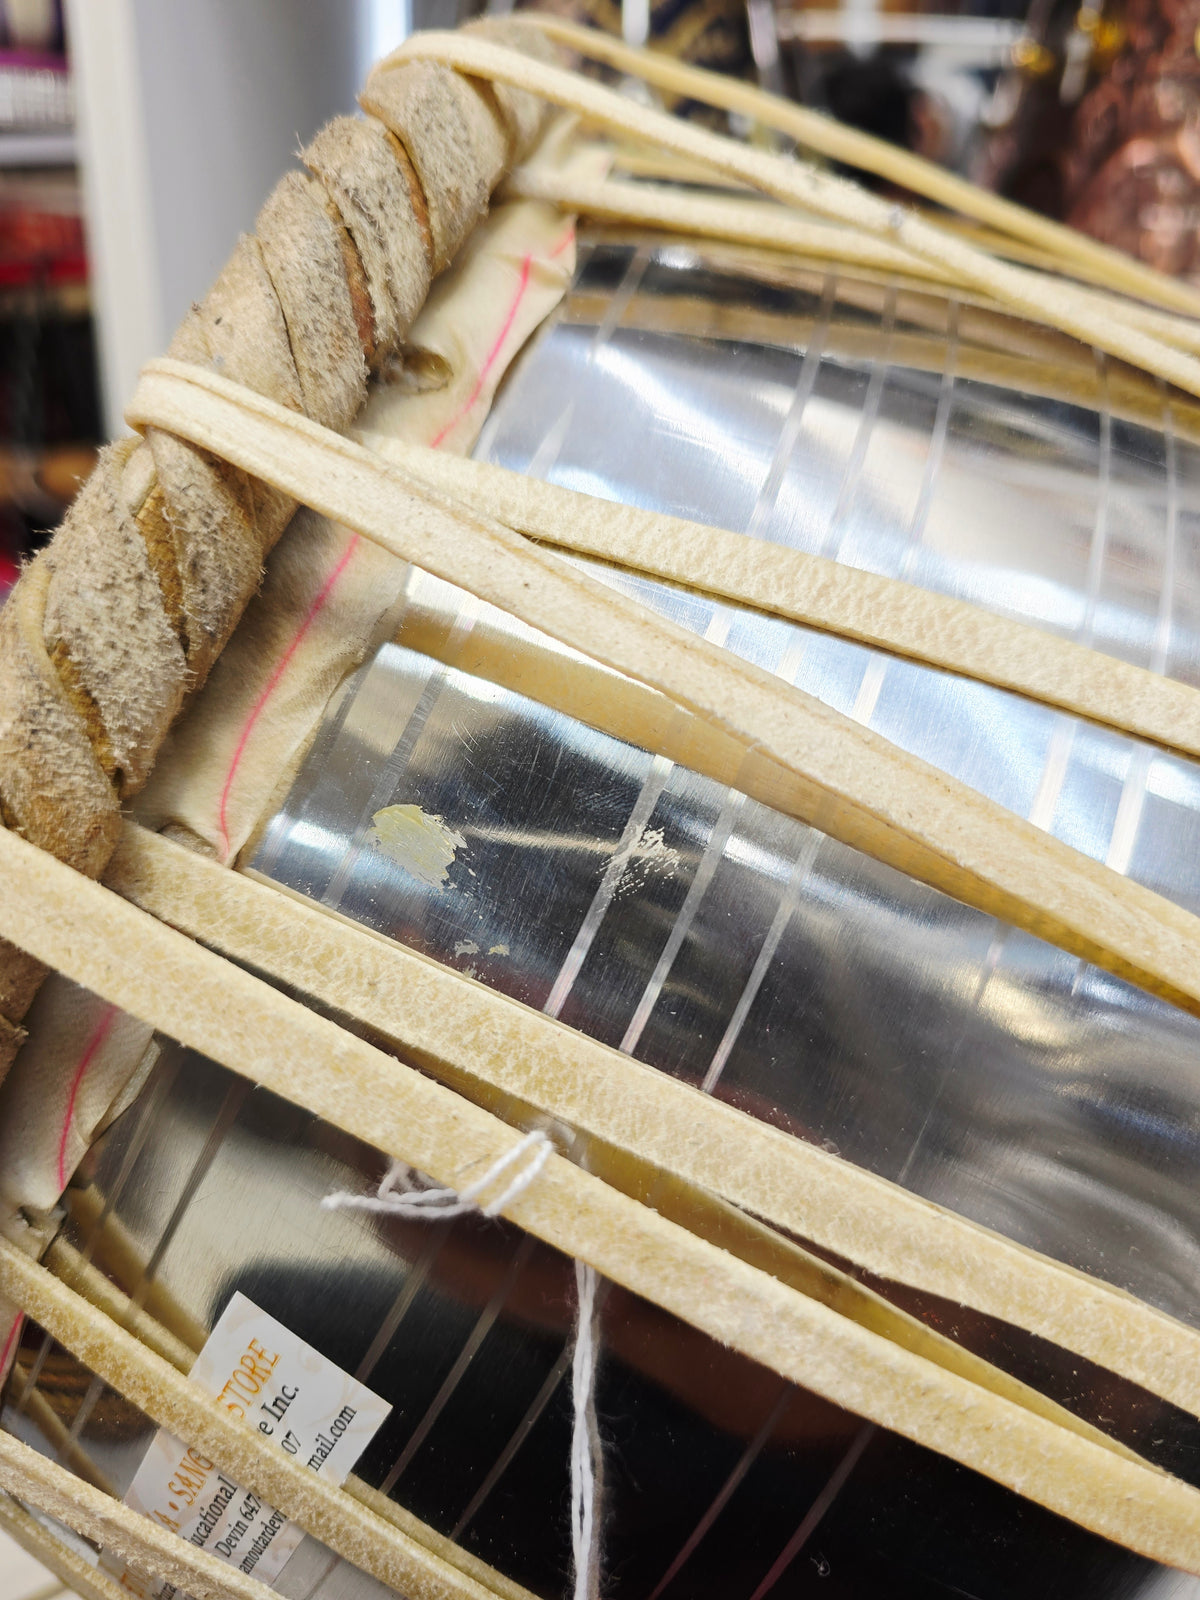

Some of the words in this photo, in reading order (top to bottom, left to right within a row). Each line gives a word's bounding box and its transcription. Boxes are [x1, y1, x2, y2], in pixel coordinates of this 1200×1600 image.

[217, 1338, 281, 1418] STORE
[183, 1475, 238, 1547] ucational
[261, 1384, 300, 1422] Inc.
[214, 1519, 249, 1558] Devin
